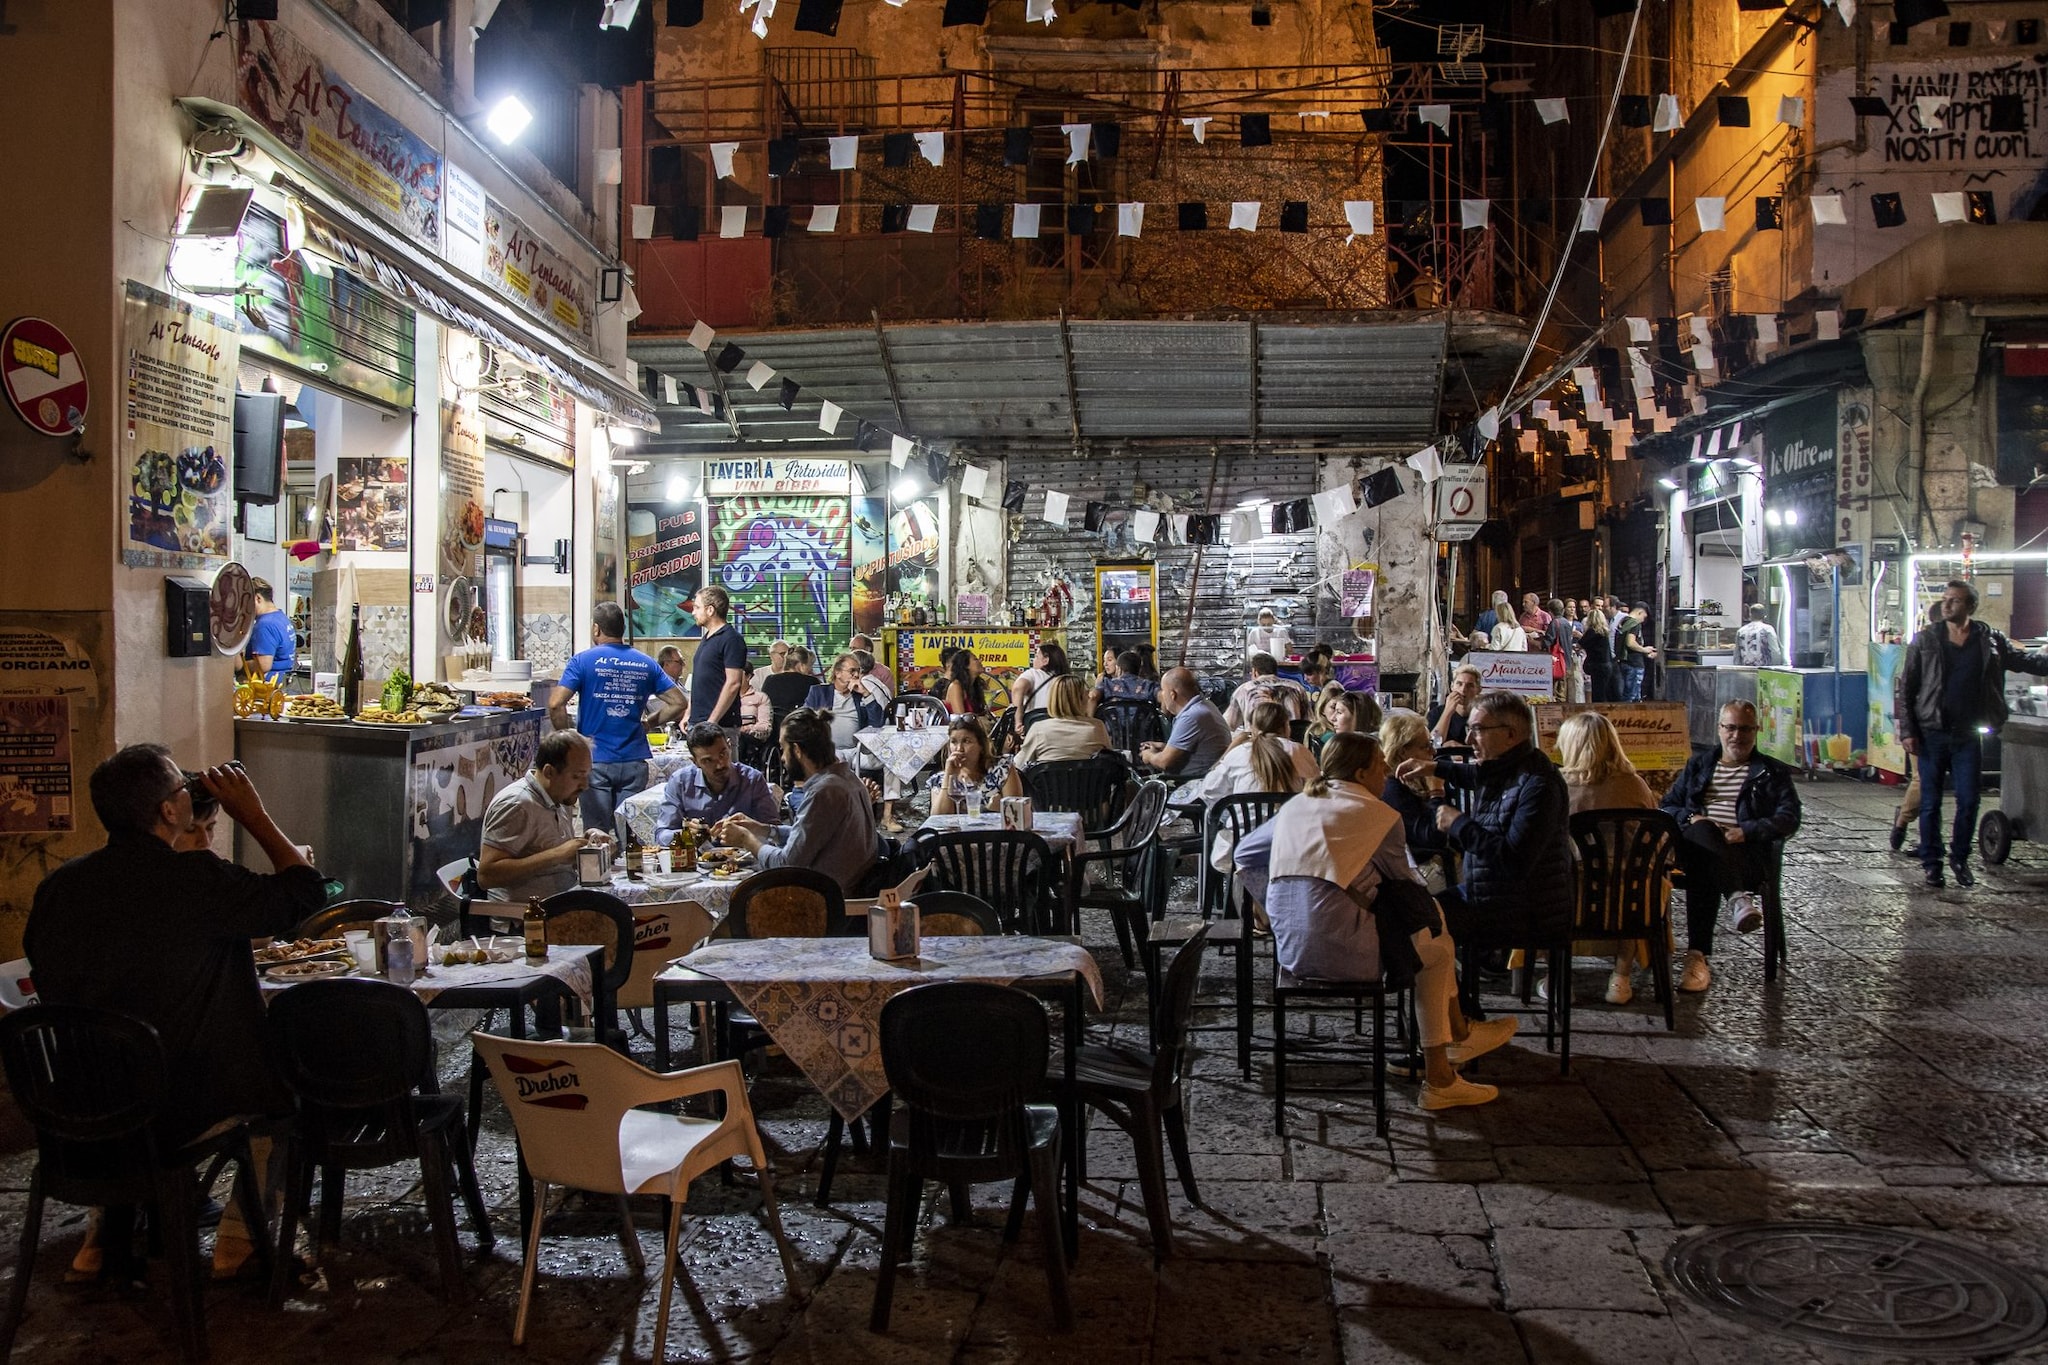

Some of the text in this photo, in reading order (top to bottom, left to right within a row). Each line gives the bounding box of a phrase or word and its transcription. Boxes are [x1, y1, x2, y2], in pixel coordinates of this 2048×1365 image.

[1890, 73, 1958, 105] MANU
[288, 65, 320, 117] Al
[327, 84, 419, 189] Tentacolo
[505, 230, 522, 262] Al
[525, 240, 576, 301] Tentacolo
[148, 320, 220, 361] Al Tentacolo
[139, 353, 155, 365] POLPO
[157, 358, 177, 370] BOLLITO
[182, 365, 200, 377] FRUTTI
[200, 371, 206, 379] DI
[206, 372, 219, 384] MARE
[158, 367, 181, 381] OCTOPUS
[181, 374, 192, 384] AND
[193, 377, 214, 391] SEAFOOD
[178, 394, 202, 406] MARISCOS
[185, 385, 193, 393] ET
[216, 395, 226, 404] MER
[785, 460, 847, 481] Pirtusiddu
[1839, 430, 1852, 510] Monaco
[735, 481, 765, 491] VINI
[659, 511, 695, 532] PUB
[628, 531, 701, 561] DRINKERIA
[922, 636, 974, 649] TAVERNA
[1, 660, 91, 671] ORGIAMO
[595, 657, 648, 668] Al Tentacolo
[979, 654, 1007, 663] BIRRA
[1482, 664, 1546, 678] Maurizio
[1602, 713, 1672, 731] entacolo
[886, 892, 896, 903] 17
[635, 921, 669, 941] eher
[515, 1072, 580, 1097] Dreher
